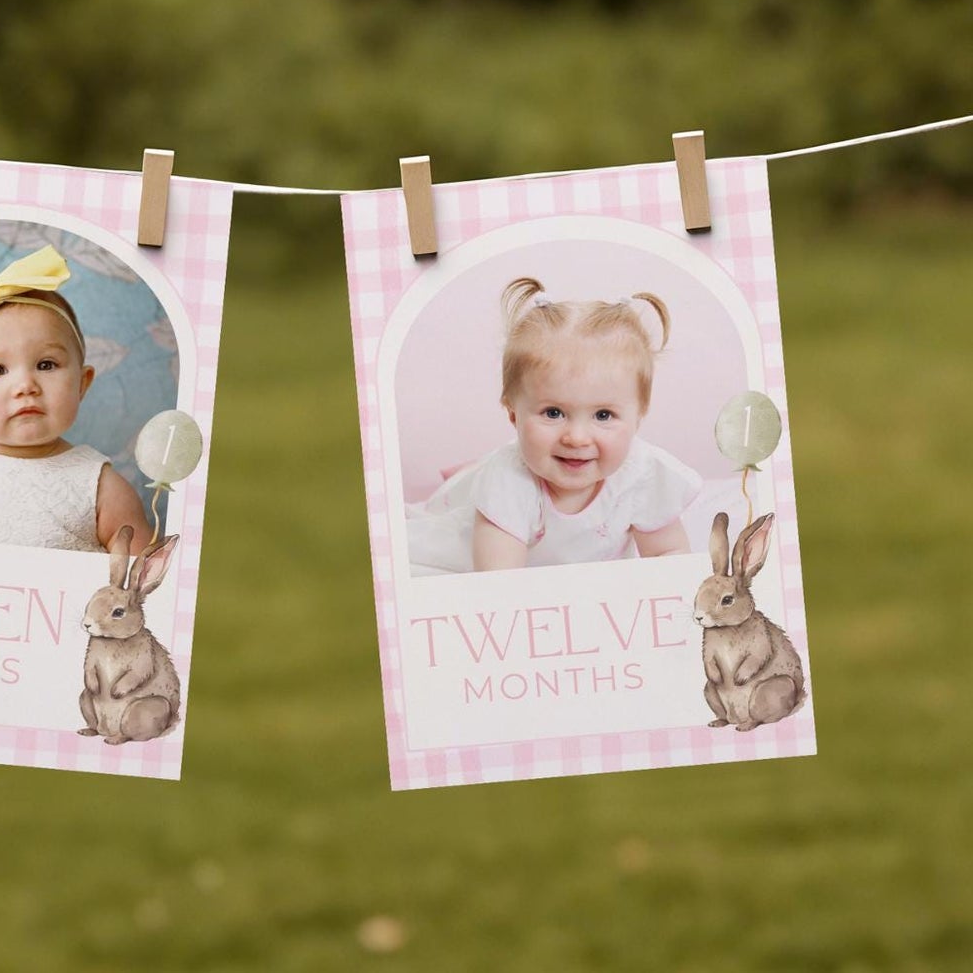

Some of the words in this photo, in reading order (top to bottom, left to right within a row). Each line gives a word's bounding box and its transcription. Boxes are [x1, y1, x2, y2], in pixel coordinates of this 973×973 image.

[162, 425, 176, 465] 1
[744, 405, 751, 447] 1
[410, 595, 688, 668] TWELVE
[463, 663, 645, 704] MONTHS
